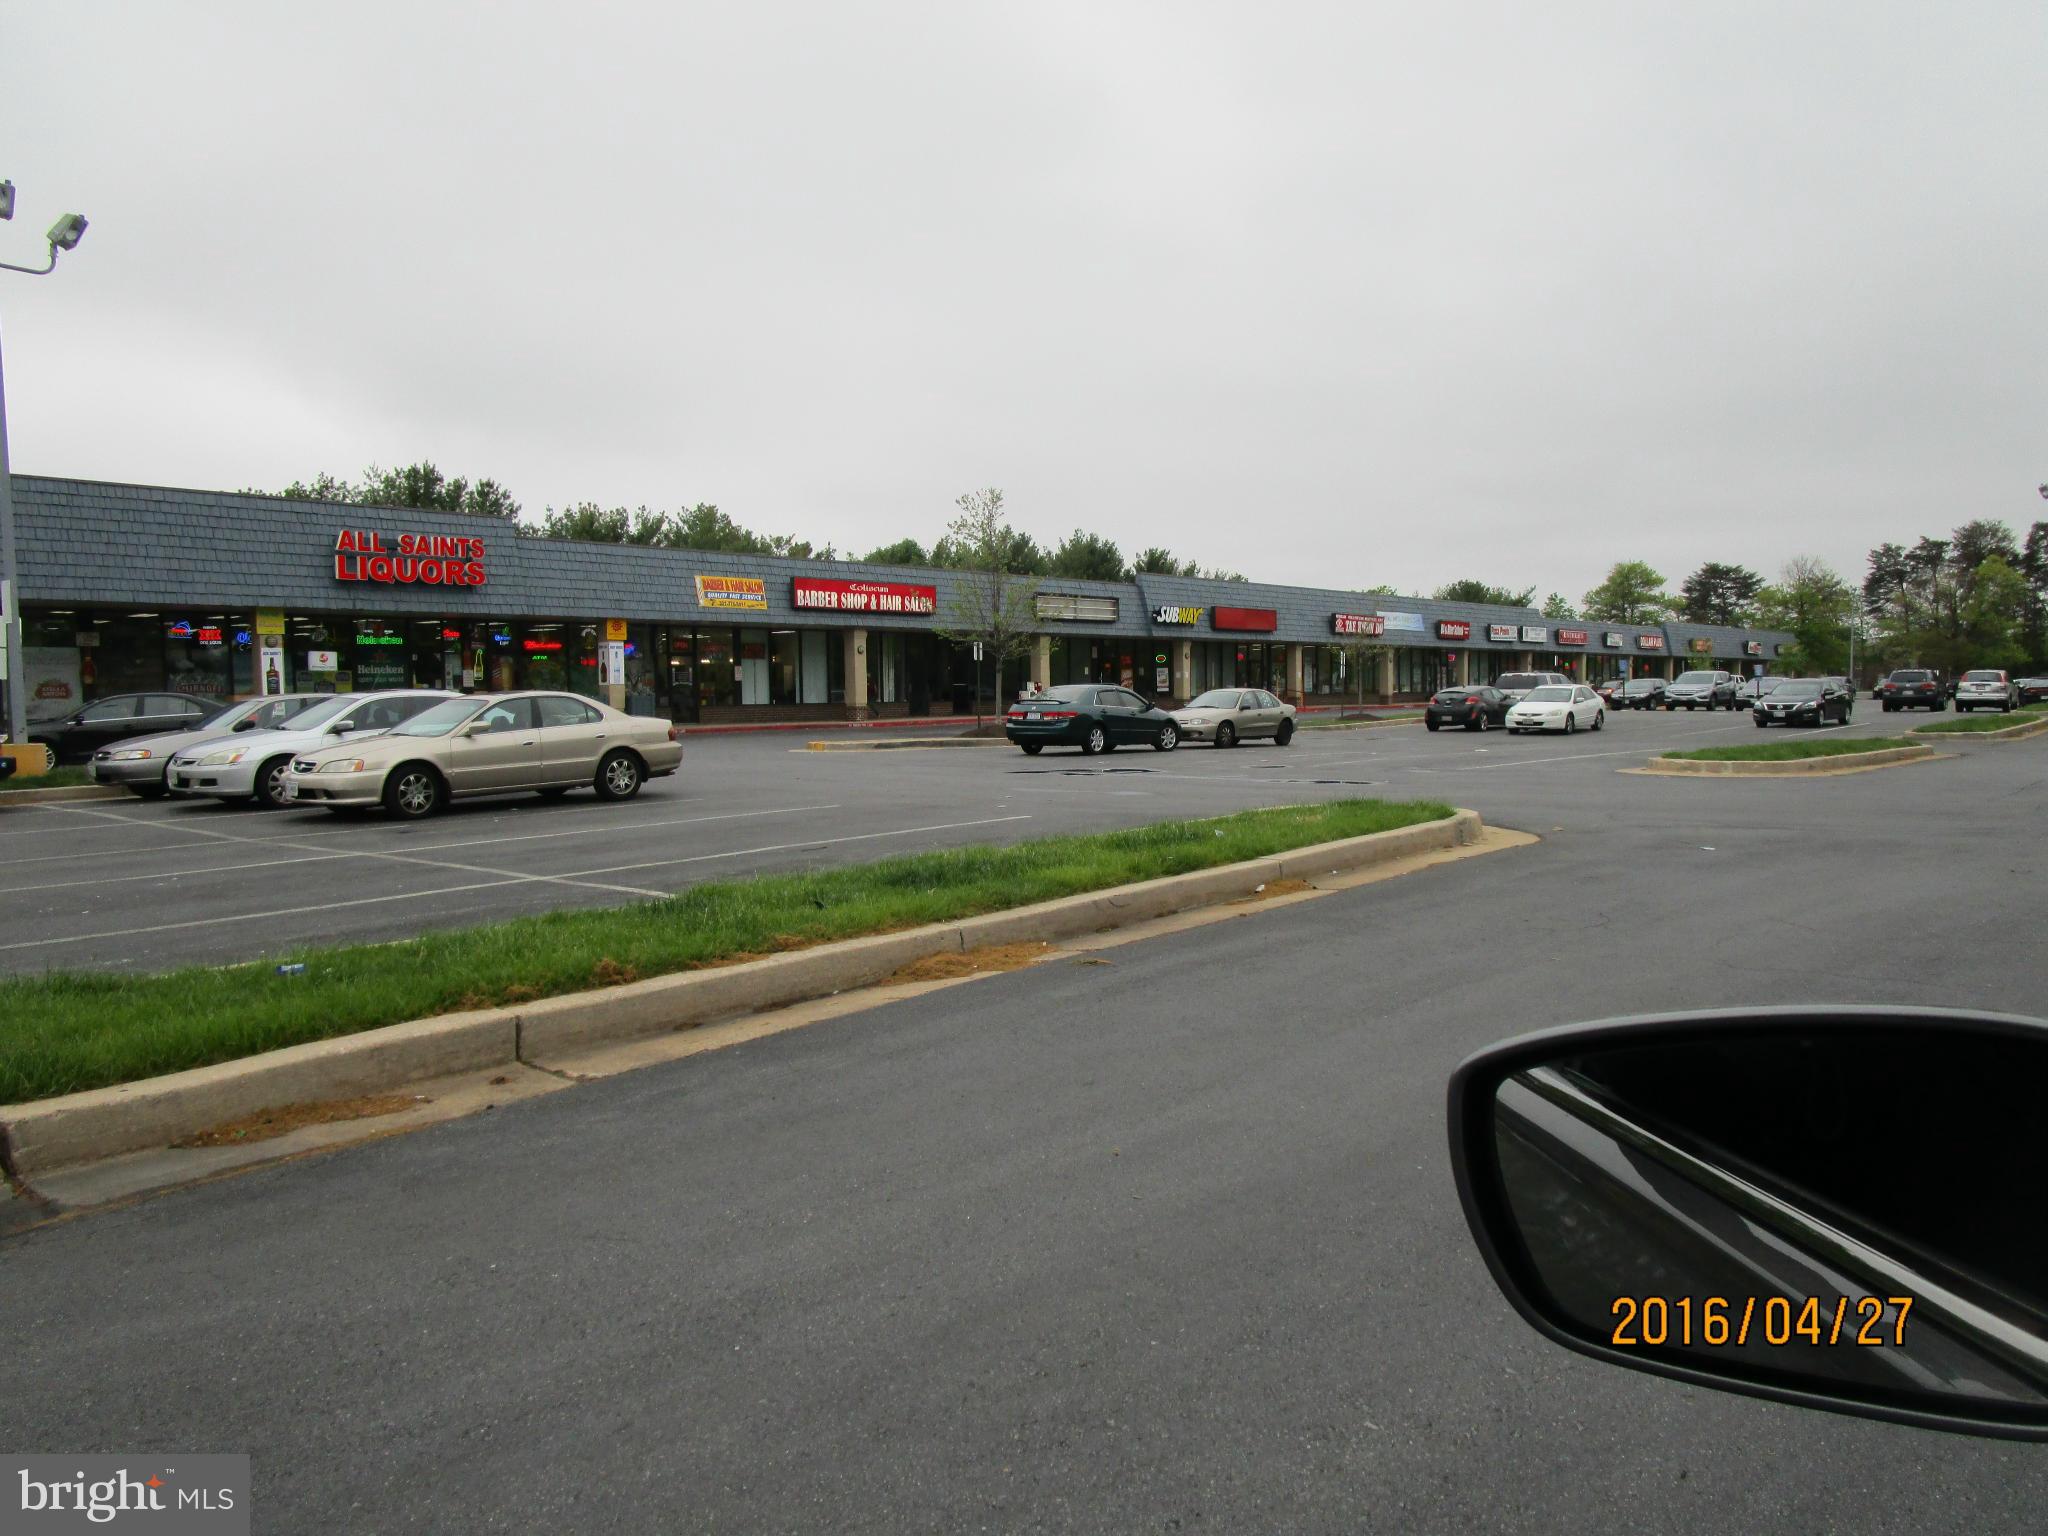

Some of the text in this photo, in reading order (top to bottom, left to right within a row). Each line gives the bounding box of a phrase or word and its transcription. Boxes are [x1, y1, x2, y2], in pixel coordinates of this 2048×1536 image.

[335, 529, 486, 559] ALL SAINTS
[335, 554, 487, 585] LIQUORS
[703, 578, 724, 591] BARBER
[731, 579, 745, 592] HAIR
[746, 580, 763, 593] SALON
[797, 589, 933, 613] BARBER SHOP & HAIR SALON
[1153, 606, 1204, 624] SUBWAY
[357, 665, 404, 674] Heineken
